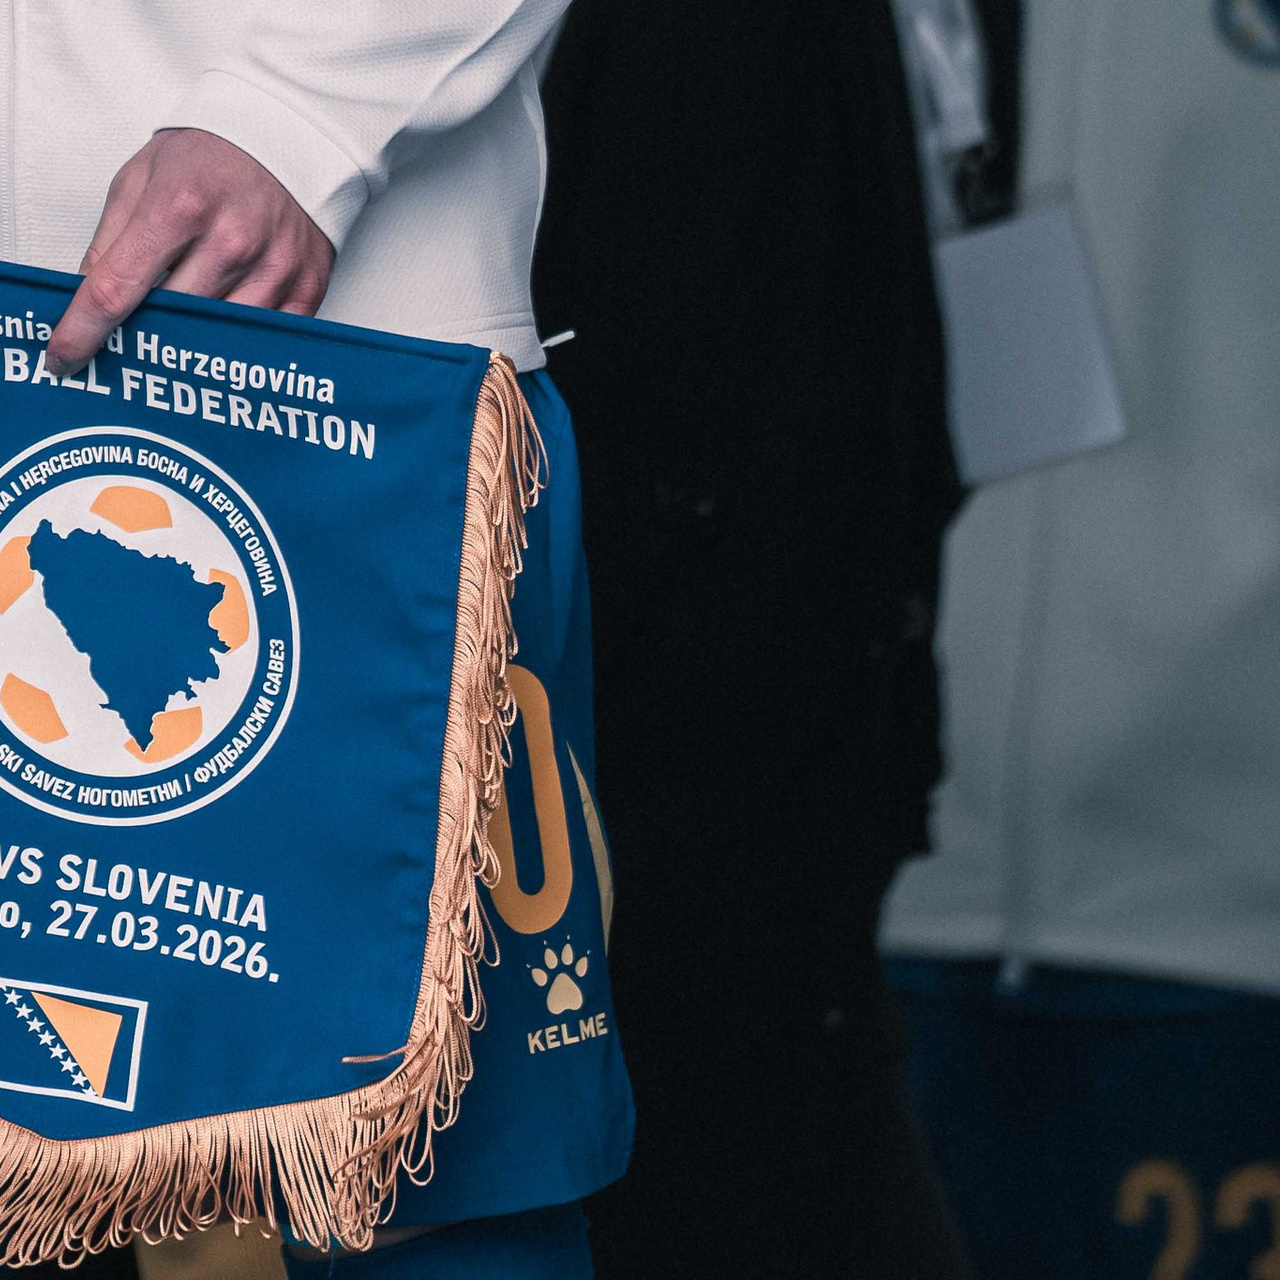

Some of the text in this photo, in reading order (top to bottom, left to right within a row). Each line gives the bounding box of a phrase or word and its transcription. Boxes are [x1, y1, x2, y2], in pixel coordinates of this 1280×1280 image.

[136, 330, 335, 405] Herzegovina
[121, 366, 376, 460] FEDERATION
[10, 480, 23, 497] I
[18, 445, 133, 491] HERCEGOVINA
[136, 448, 277, 596] БОСНА И ХЕРЦЕГОВИНА
[77, 772, 183, 808] НОГОМЕТНИ
[193, 696, 276, 784] ФУДБАЛСКИ
[263, 638, 285, 696] САВЕЗ
[21, 763, 74, 802] SAVEZ
[55, 853, 268, 932] SLOVENIA
[45, 899, 280, 983] 27.03.2026.
[527, 1012, 608, 1055] KELME
